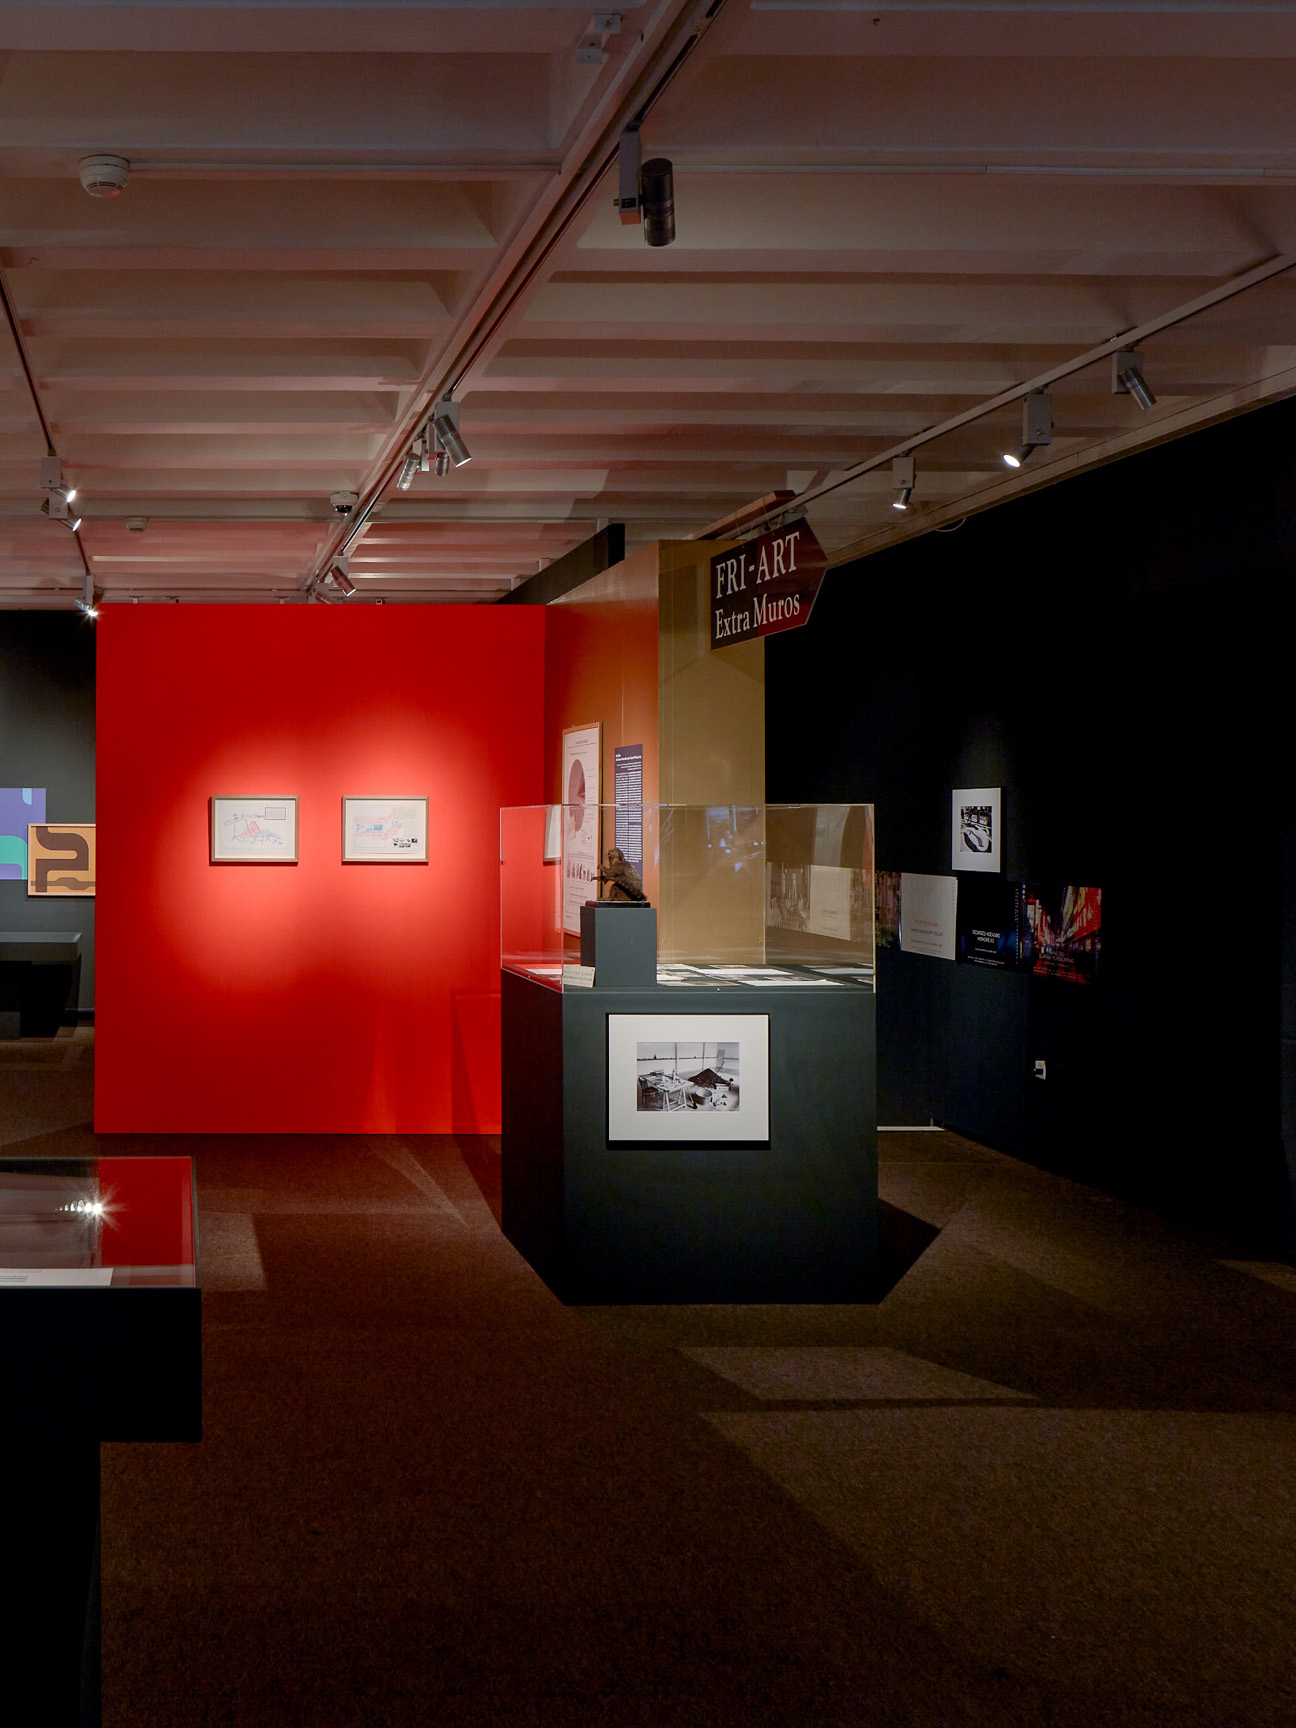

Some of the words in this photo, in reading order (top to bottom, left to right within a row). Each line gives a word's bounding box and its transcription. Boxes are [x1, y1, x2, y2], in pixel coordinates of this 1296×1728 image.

[716, 531, 800, 599] FRI-ART
[715, 608, 750, 639] Extra
[753, 593, 800, 628] Muros
